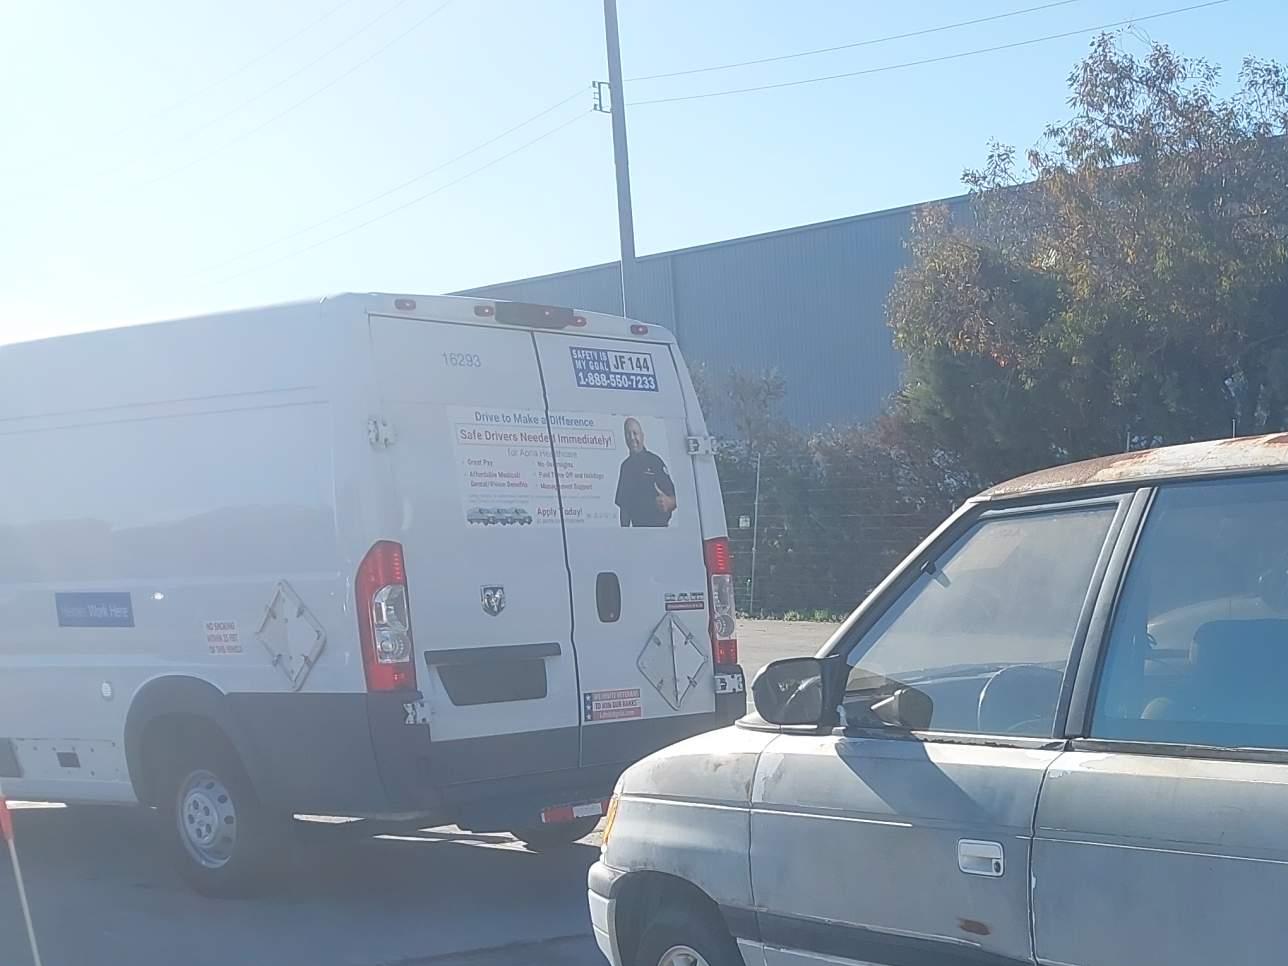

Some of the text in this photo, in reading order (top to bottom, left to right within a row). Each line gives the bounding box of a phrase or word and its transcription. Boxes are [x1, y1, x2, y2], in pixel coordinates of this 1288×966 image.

[572, 349, 608, 361] SAFETY IS
[576, 360, 609, 371] MY GOAL
[579, 372, 656, 389] 1-888-550-7233
[475, 411, 500, 423] Drive
[502, 413, 512, 423] to
[514, 413, 540, 425] Make
[550, 415, 594, 427] Difference
[460, 429, 482, 441] Safe
[485, 428, 518, 442] Drivers
[558, 434, 612, 448] Immediately!
[537, 507, 556, 517] Apply
